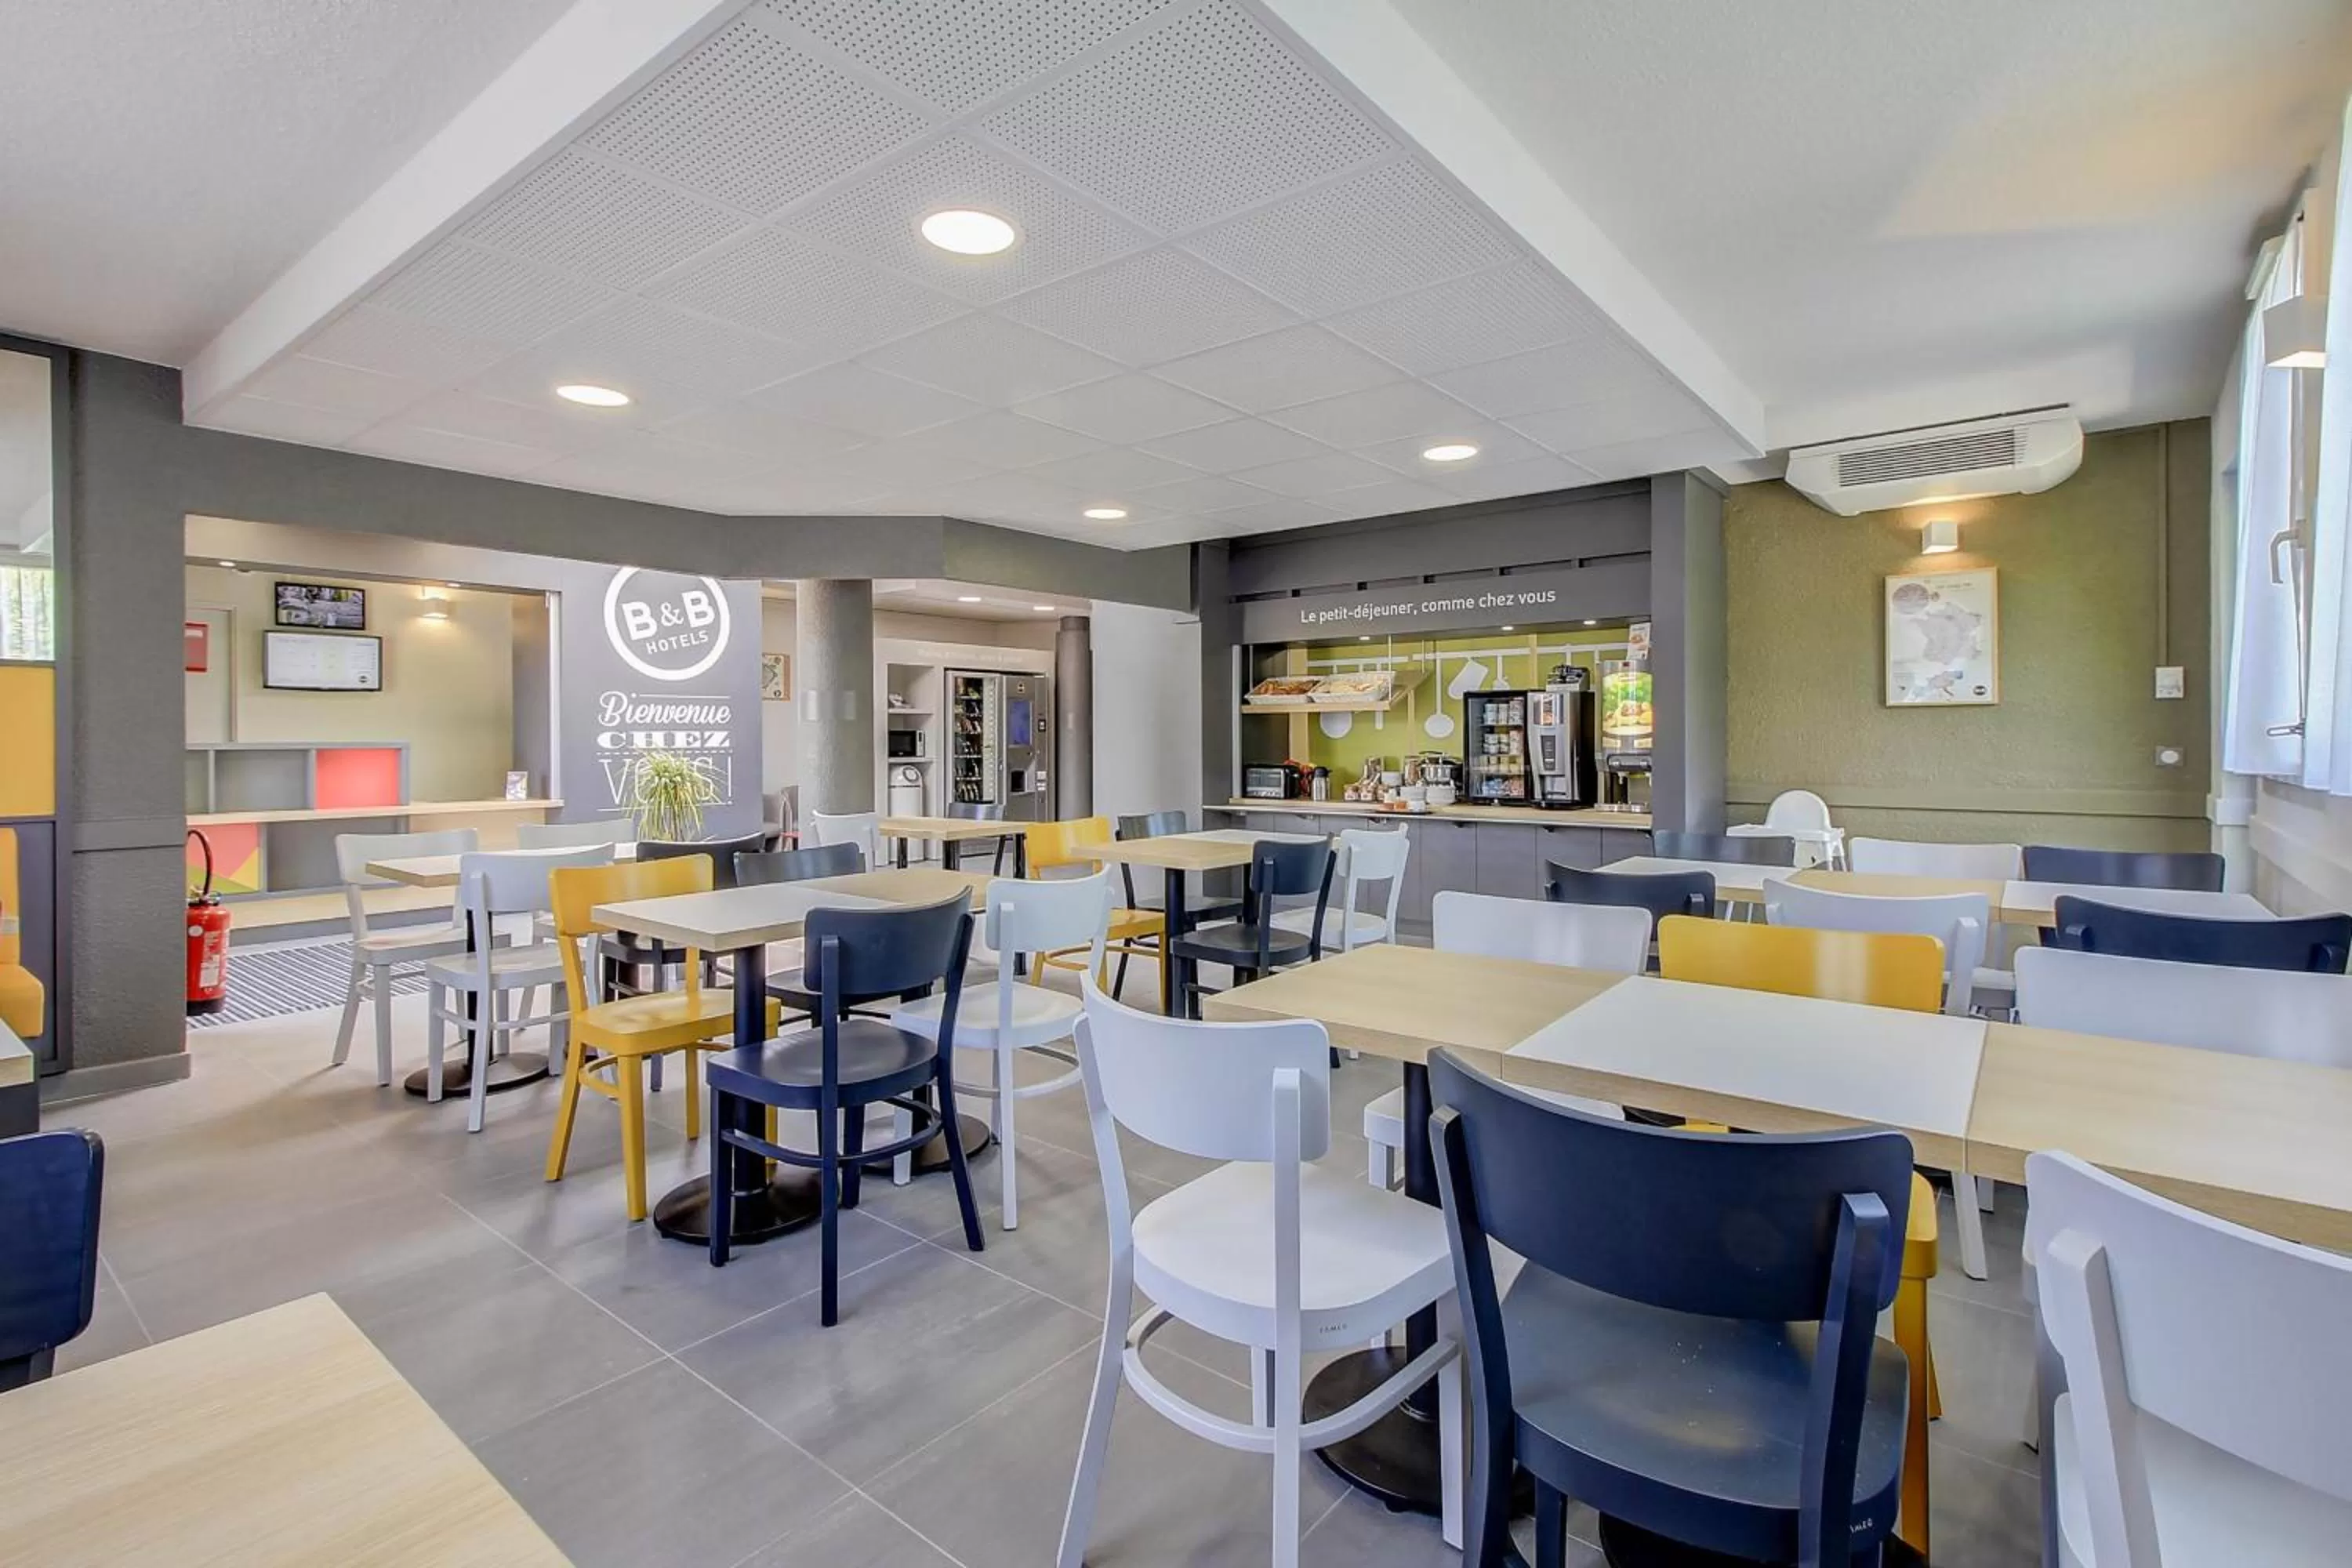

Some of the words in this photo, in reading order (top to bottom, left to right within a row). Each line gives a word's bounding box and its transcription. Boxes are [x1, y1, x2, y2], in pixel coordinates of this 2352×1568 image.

[1301, 610, 1316, 623] Le
[1319, 602, 1417, 624] petit-déjeuner,
[1421, 598, 1474, 613] comme
[1479, 593, 1514, 608] chez
[1519, 590, 1556, 604] vous
[646, 630, 710, 655] HOTELS
[599, 691, 731, 726] Bienvenue
[597, 731, 731, 749] CHEZ
